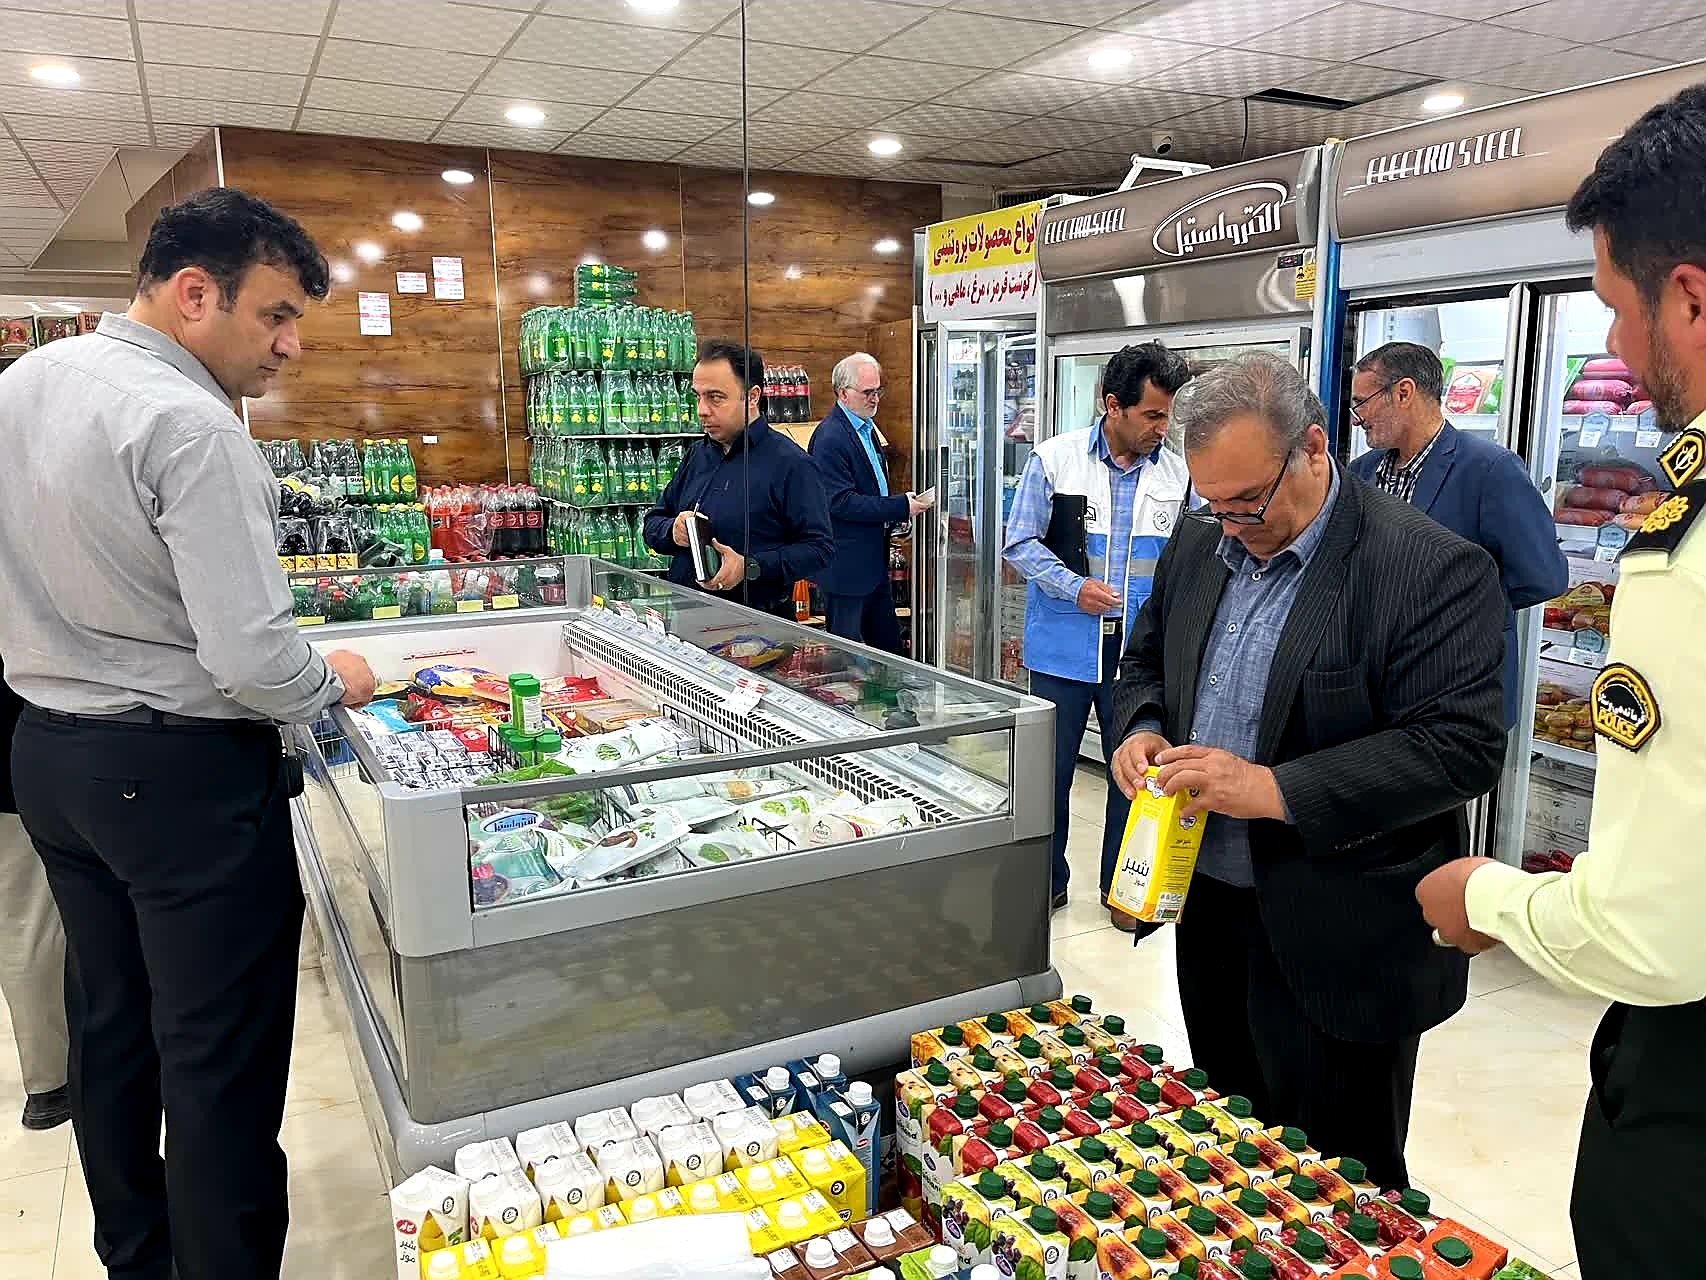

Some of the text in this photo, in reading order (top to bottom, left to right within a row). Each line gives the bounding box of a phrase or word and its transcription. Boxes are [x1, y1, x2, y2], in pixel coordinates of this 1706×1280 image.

[969, 221, 1012, 260] محصولات
[1014, 213, 1039, 255] انواع
[948, 278, 966, 306] ماهی
[1598, 708, 1638, 740] POLICE
[1121, 857, 1150, 877] شیر
